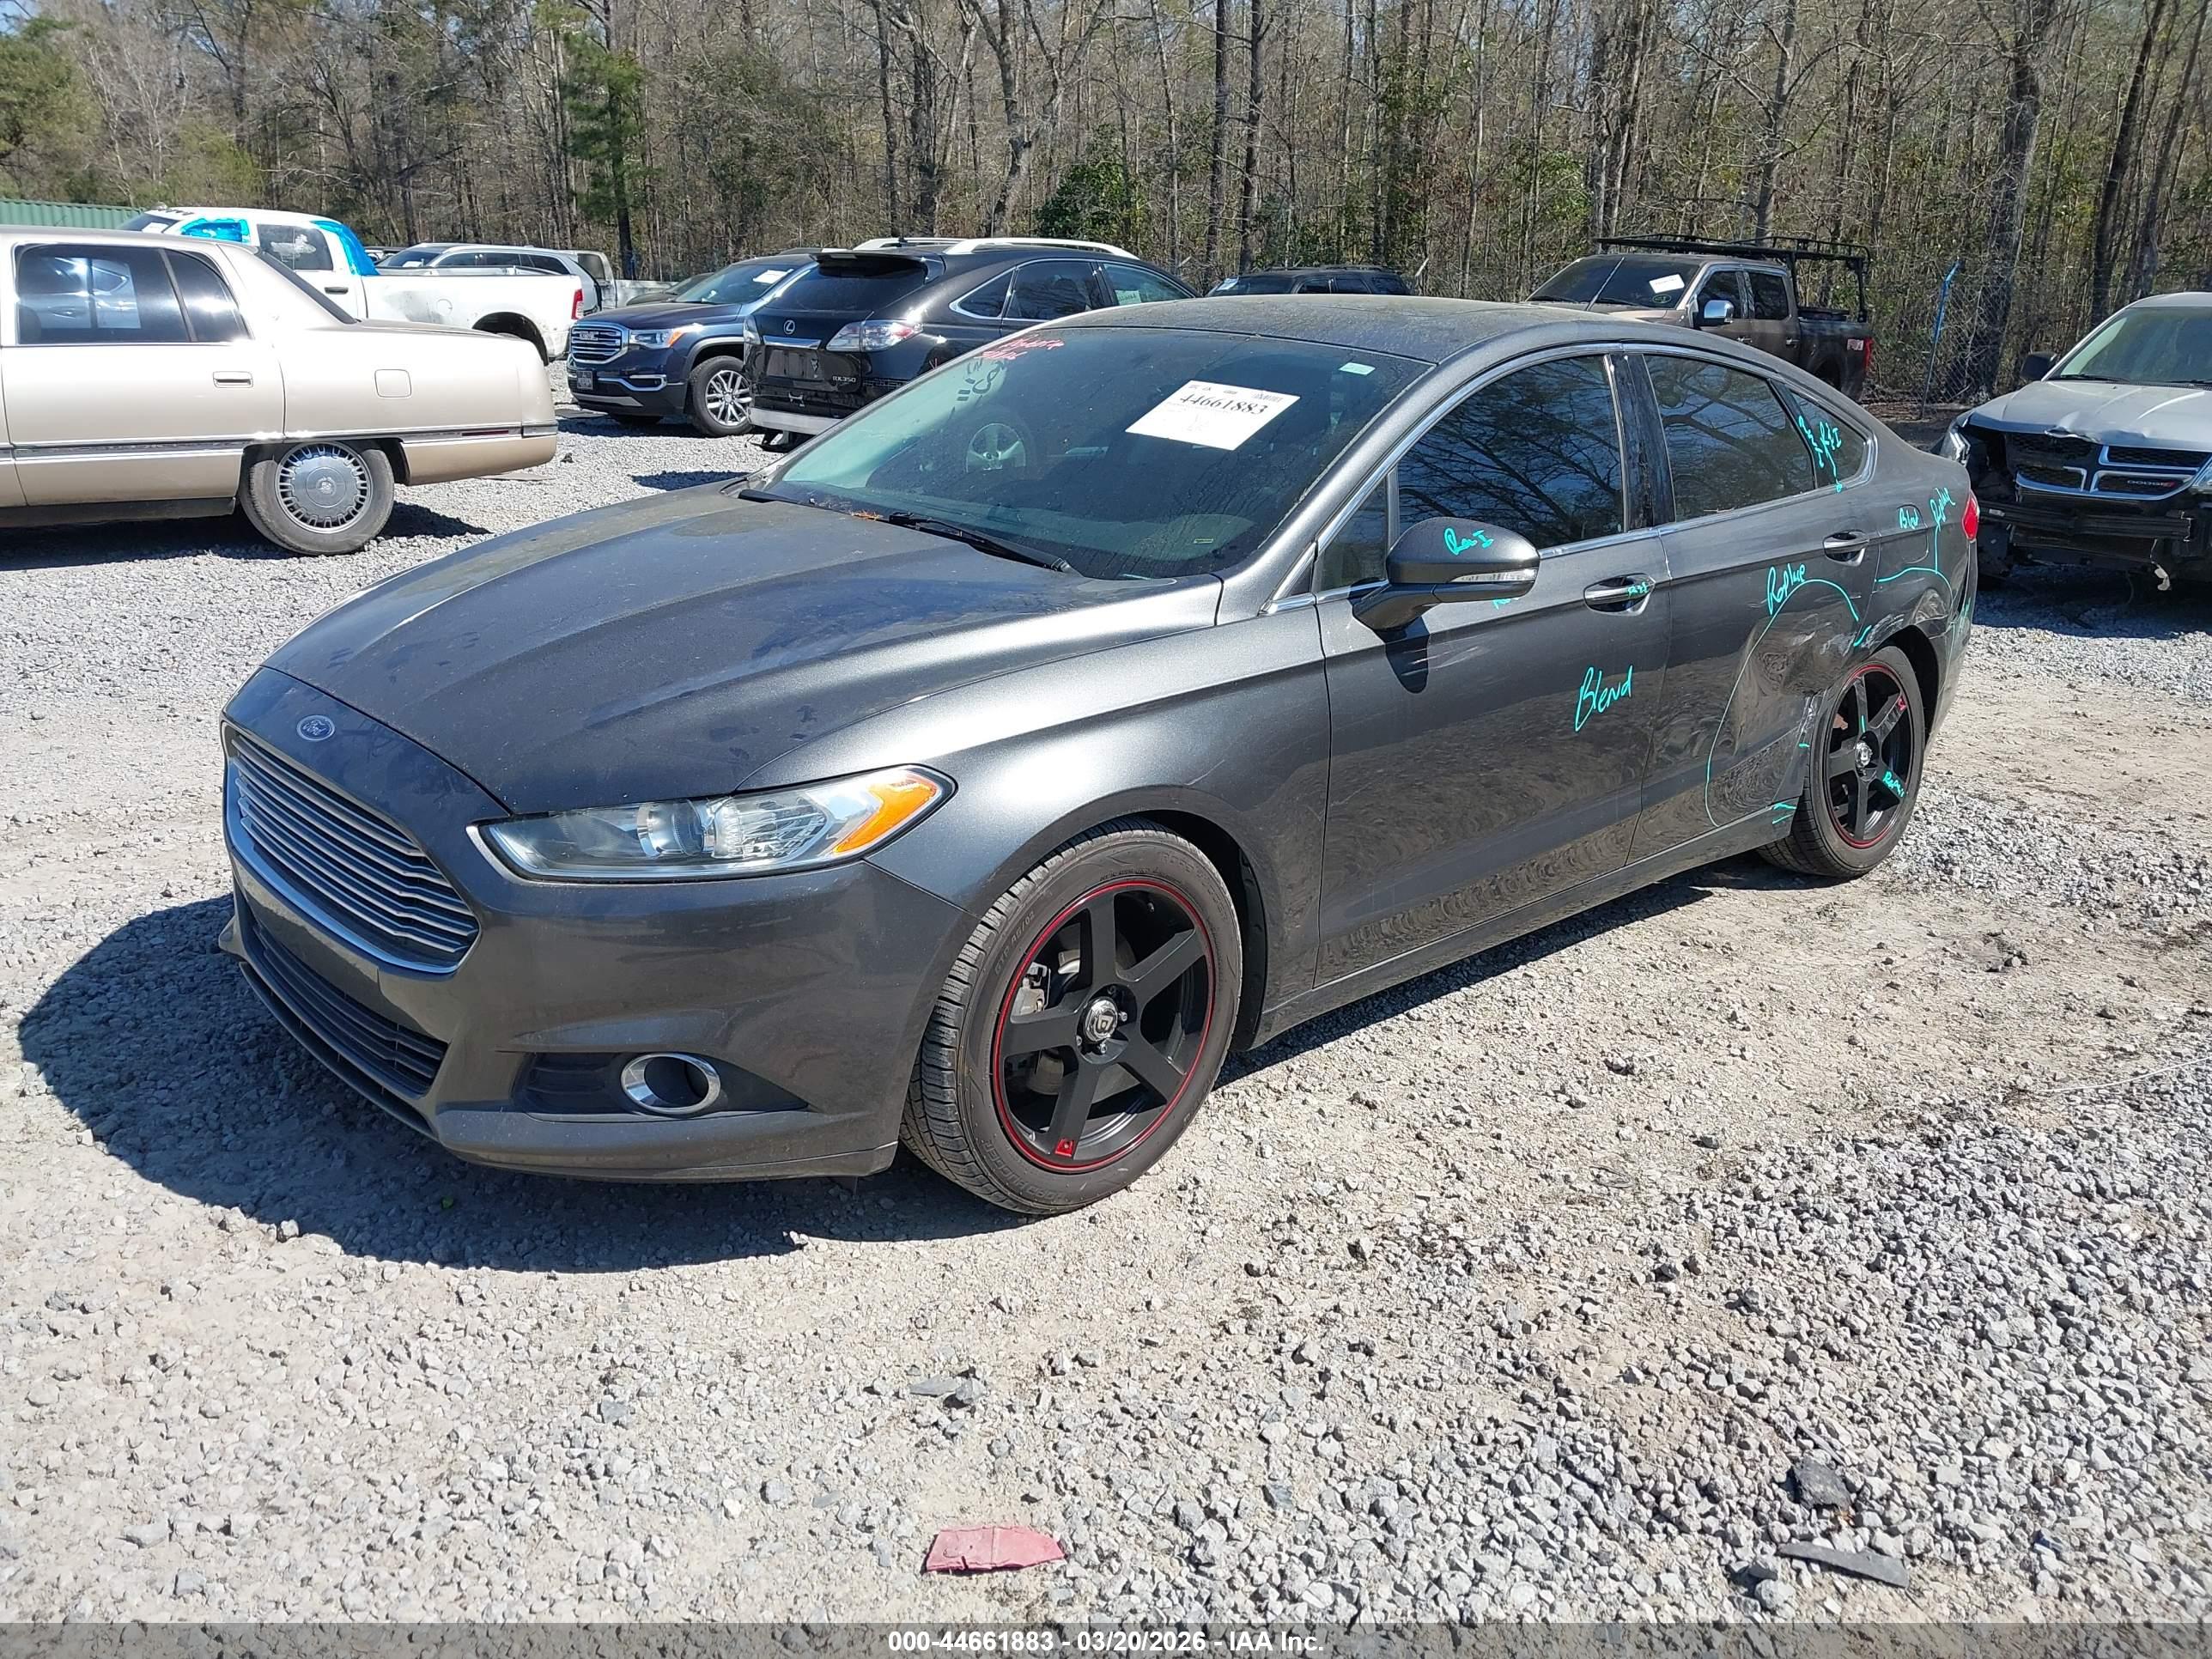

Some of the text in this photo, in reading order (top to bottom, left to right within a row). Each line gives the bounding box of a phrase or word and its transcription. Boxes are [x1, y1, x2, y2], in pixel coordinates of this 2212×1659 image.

[1180, 393, 1268, 415] 44661883
[2127, 479, 2166, 488] DODGE
[1575, 665, 1633, 732] Blend
